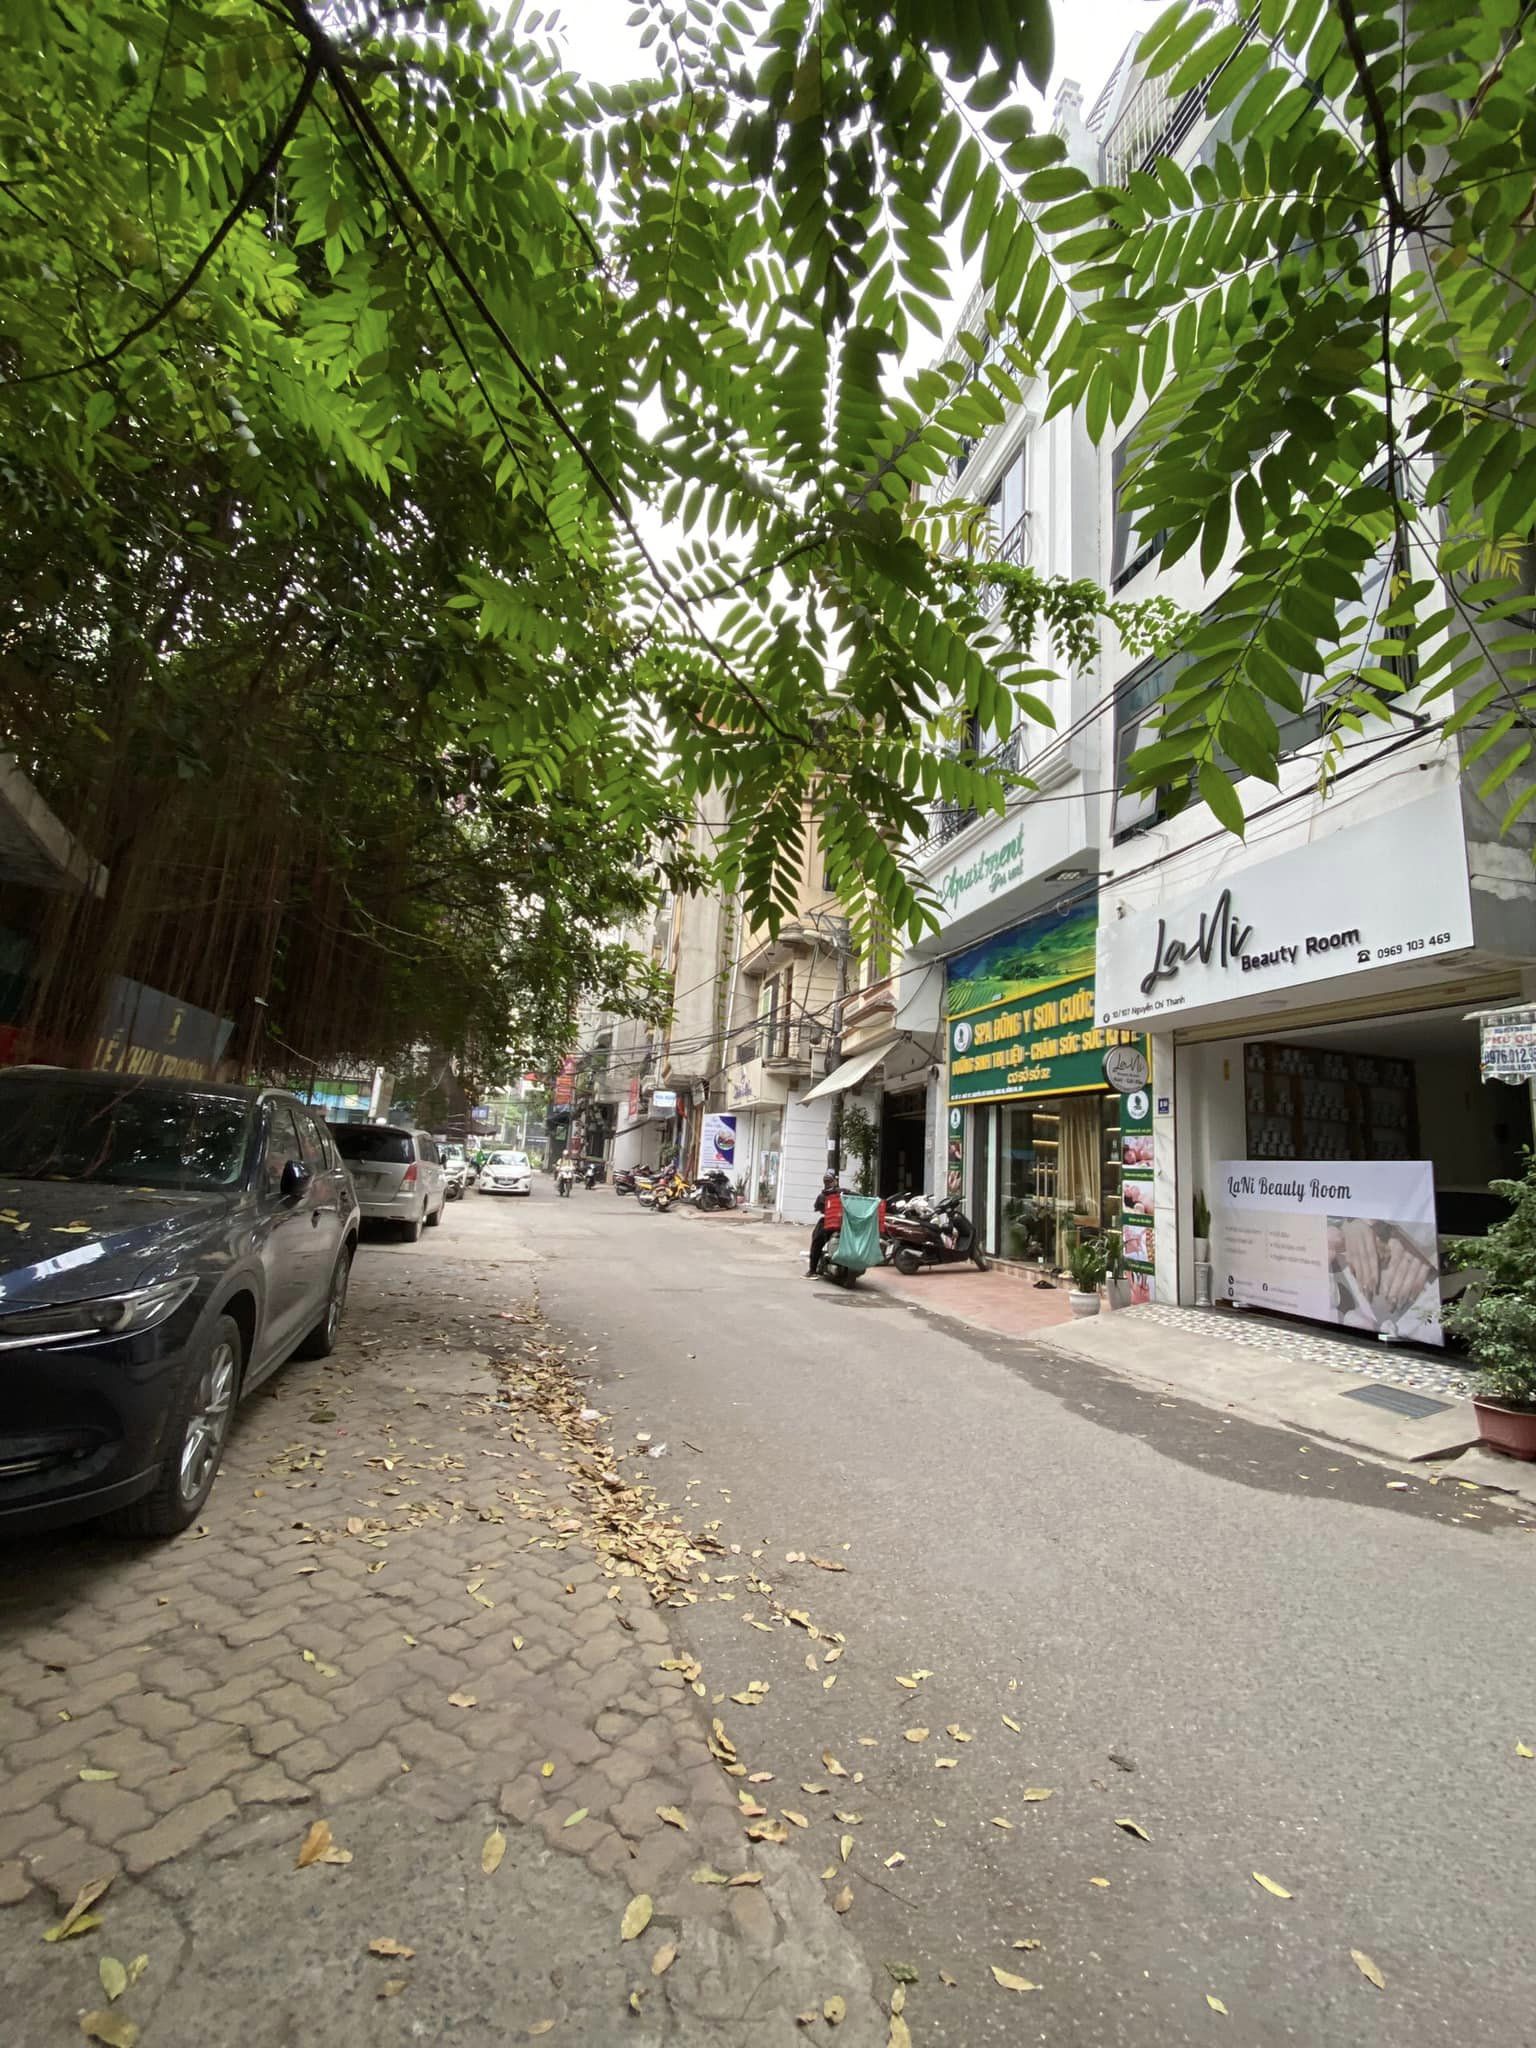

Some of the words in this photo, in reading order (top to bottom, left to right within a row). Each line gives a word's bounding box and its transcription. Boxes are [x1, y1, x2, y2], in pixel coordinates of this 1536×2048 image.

[1241, 944, 1298, 971] Beauty
[1306, 928, 1360, 954] Room
[1377, 945, 1403, 959] 0969
[1406, 938, 1424, 952] 103
[1429, 932, 1451, 946] 469
[1132, 1002, 1153, 1015] Nguyễn
[1166, 996, 1185, 1006] Thanh
[974, 1021, 993, 1046] SPA
[1023, 1009, 1032, 1033] Y
[1034, 1001, 1059, 1031] SƠN
[1060, 1032, 1081, 1054] SÓC
[1227, 1176, 1255, 1198] LaNi
[1258, 1177, 1305, 1202] Beauty
[1310, 1178, 1352, 1199] Room
